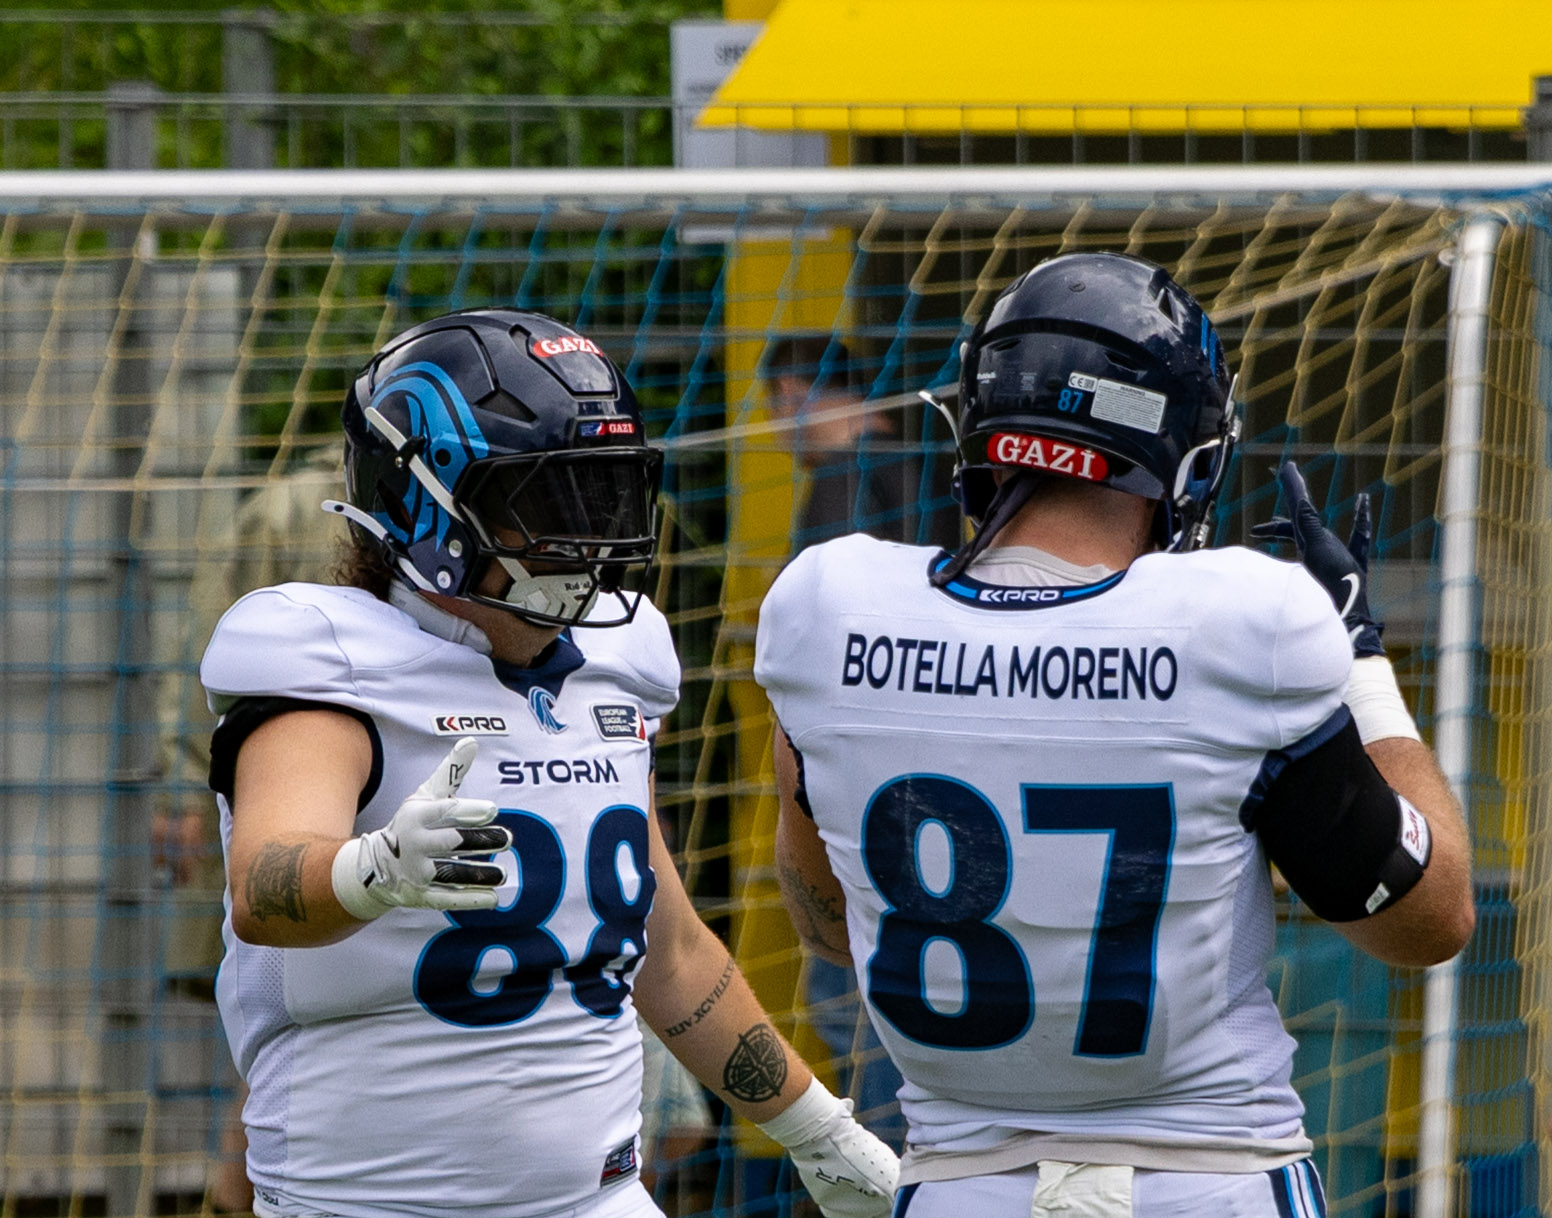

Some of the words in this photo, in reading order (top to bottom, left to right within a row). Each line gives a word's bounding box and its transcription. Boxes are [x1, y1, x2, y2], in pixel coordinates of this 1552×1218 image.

[1057, 388, 1084, 413] 87
[841, 632, 999, 697] BOTELLA
[1007, 645, 1178, 701] MORENO
[498, 759, 620, 785] STORM
[412, 804, 657, 1028] 88
[860, 772, 1178, 1059] 87
